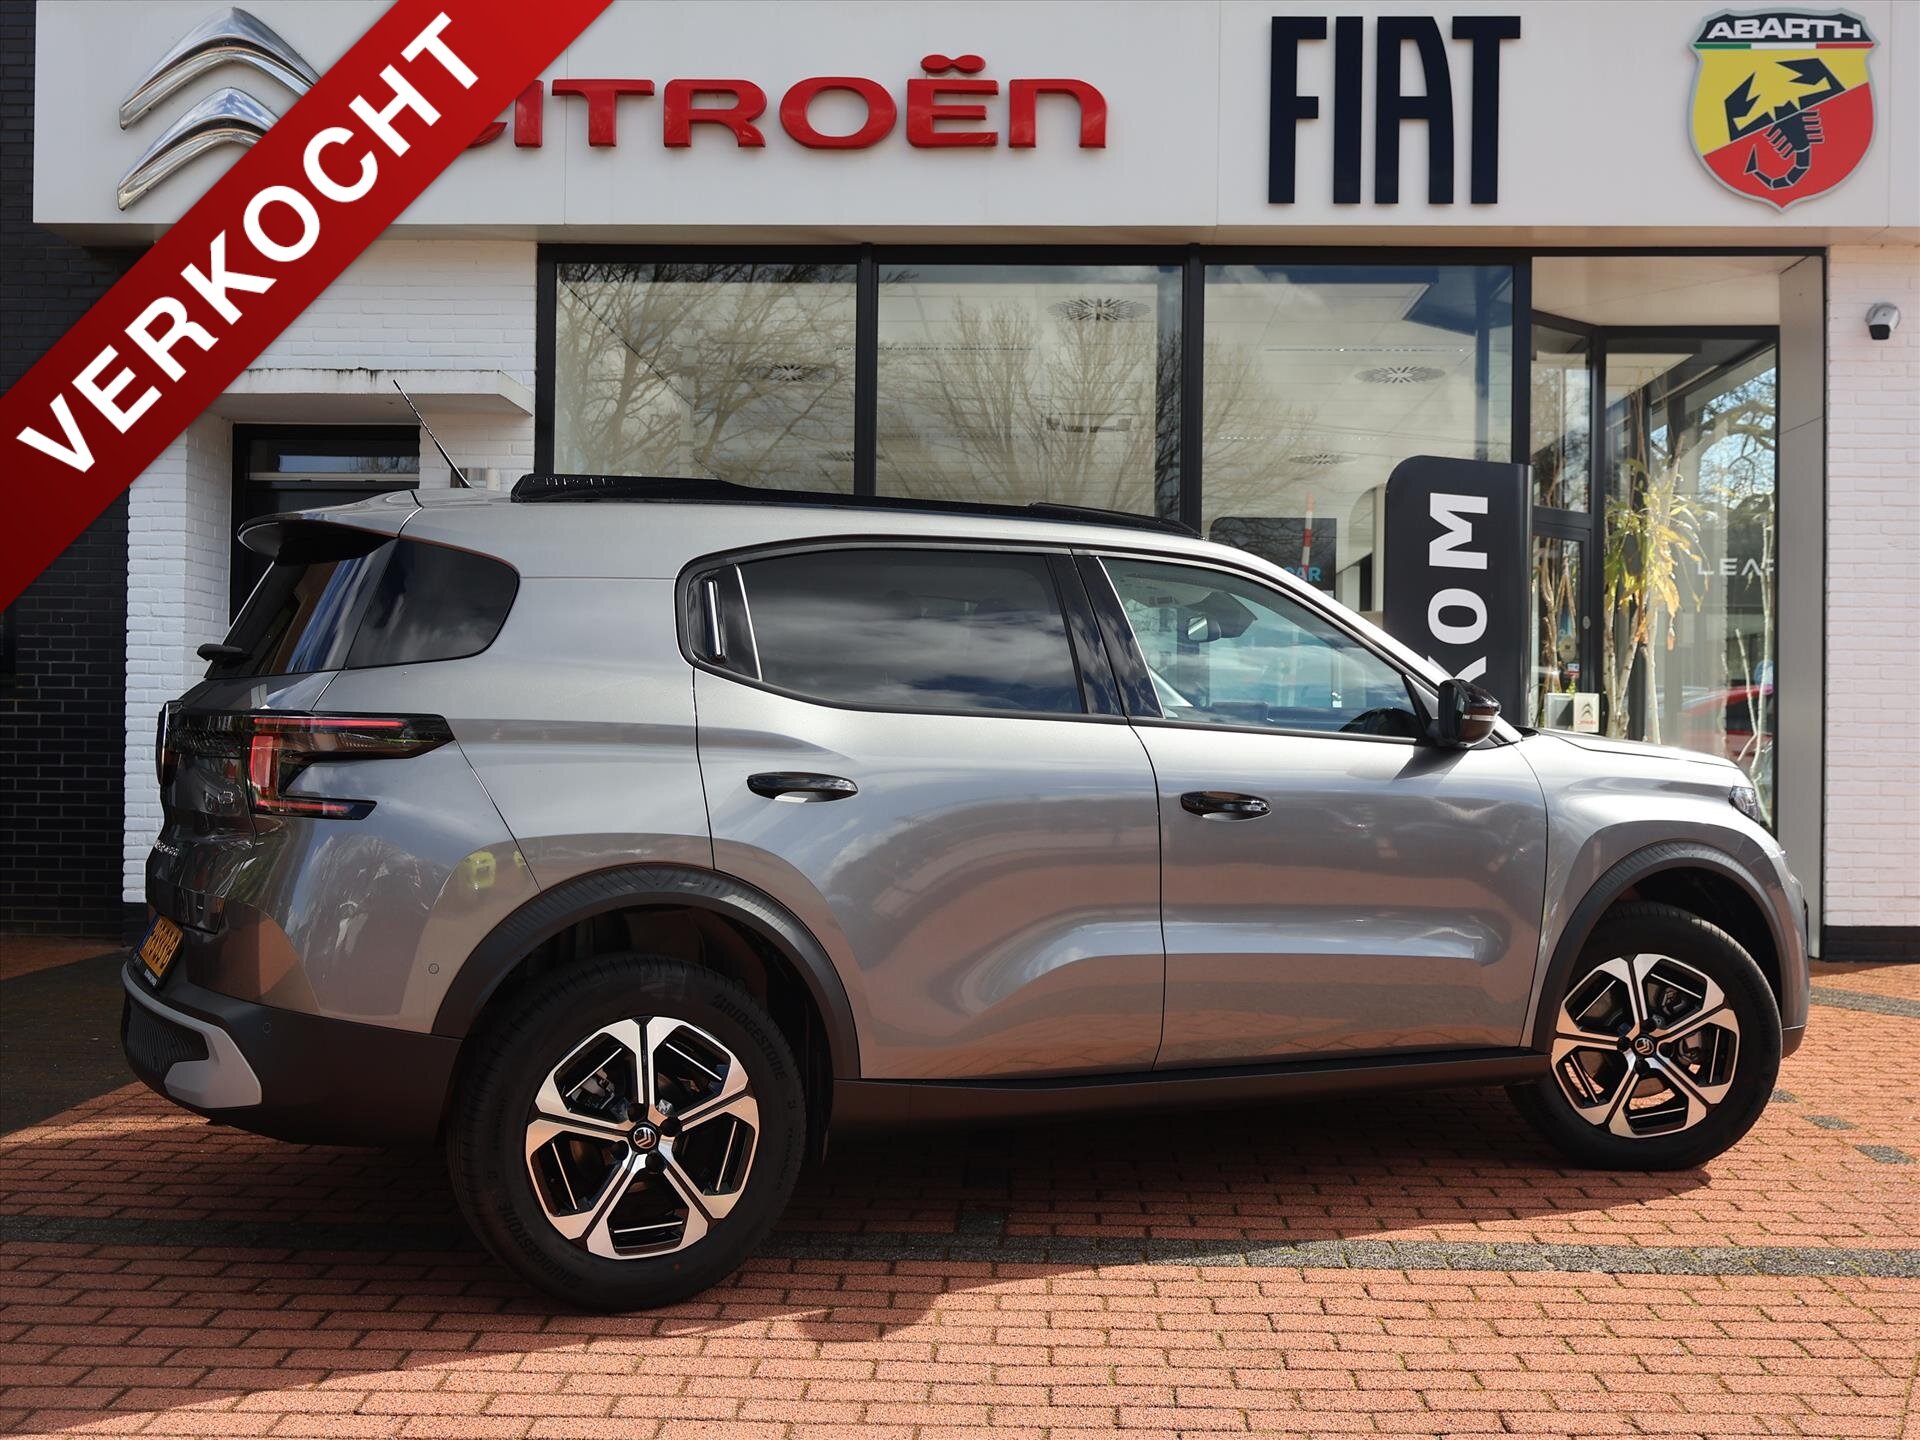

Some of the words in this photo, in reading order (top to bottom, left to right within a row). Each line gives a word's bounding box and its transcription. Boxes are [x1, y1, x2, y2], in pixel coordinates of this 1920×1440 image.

[1706, 17, 1861, 39] ABARTH
[465, 53, 1108, 149] ITROËN
[1268, 16, 1521, 204] FIAT
[710, 993, 788, 1081] BRIDGESTONE
